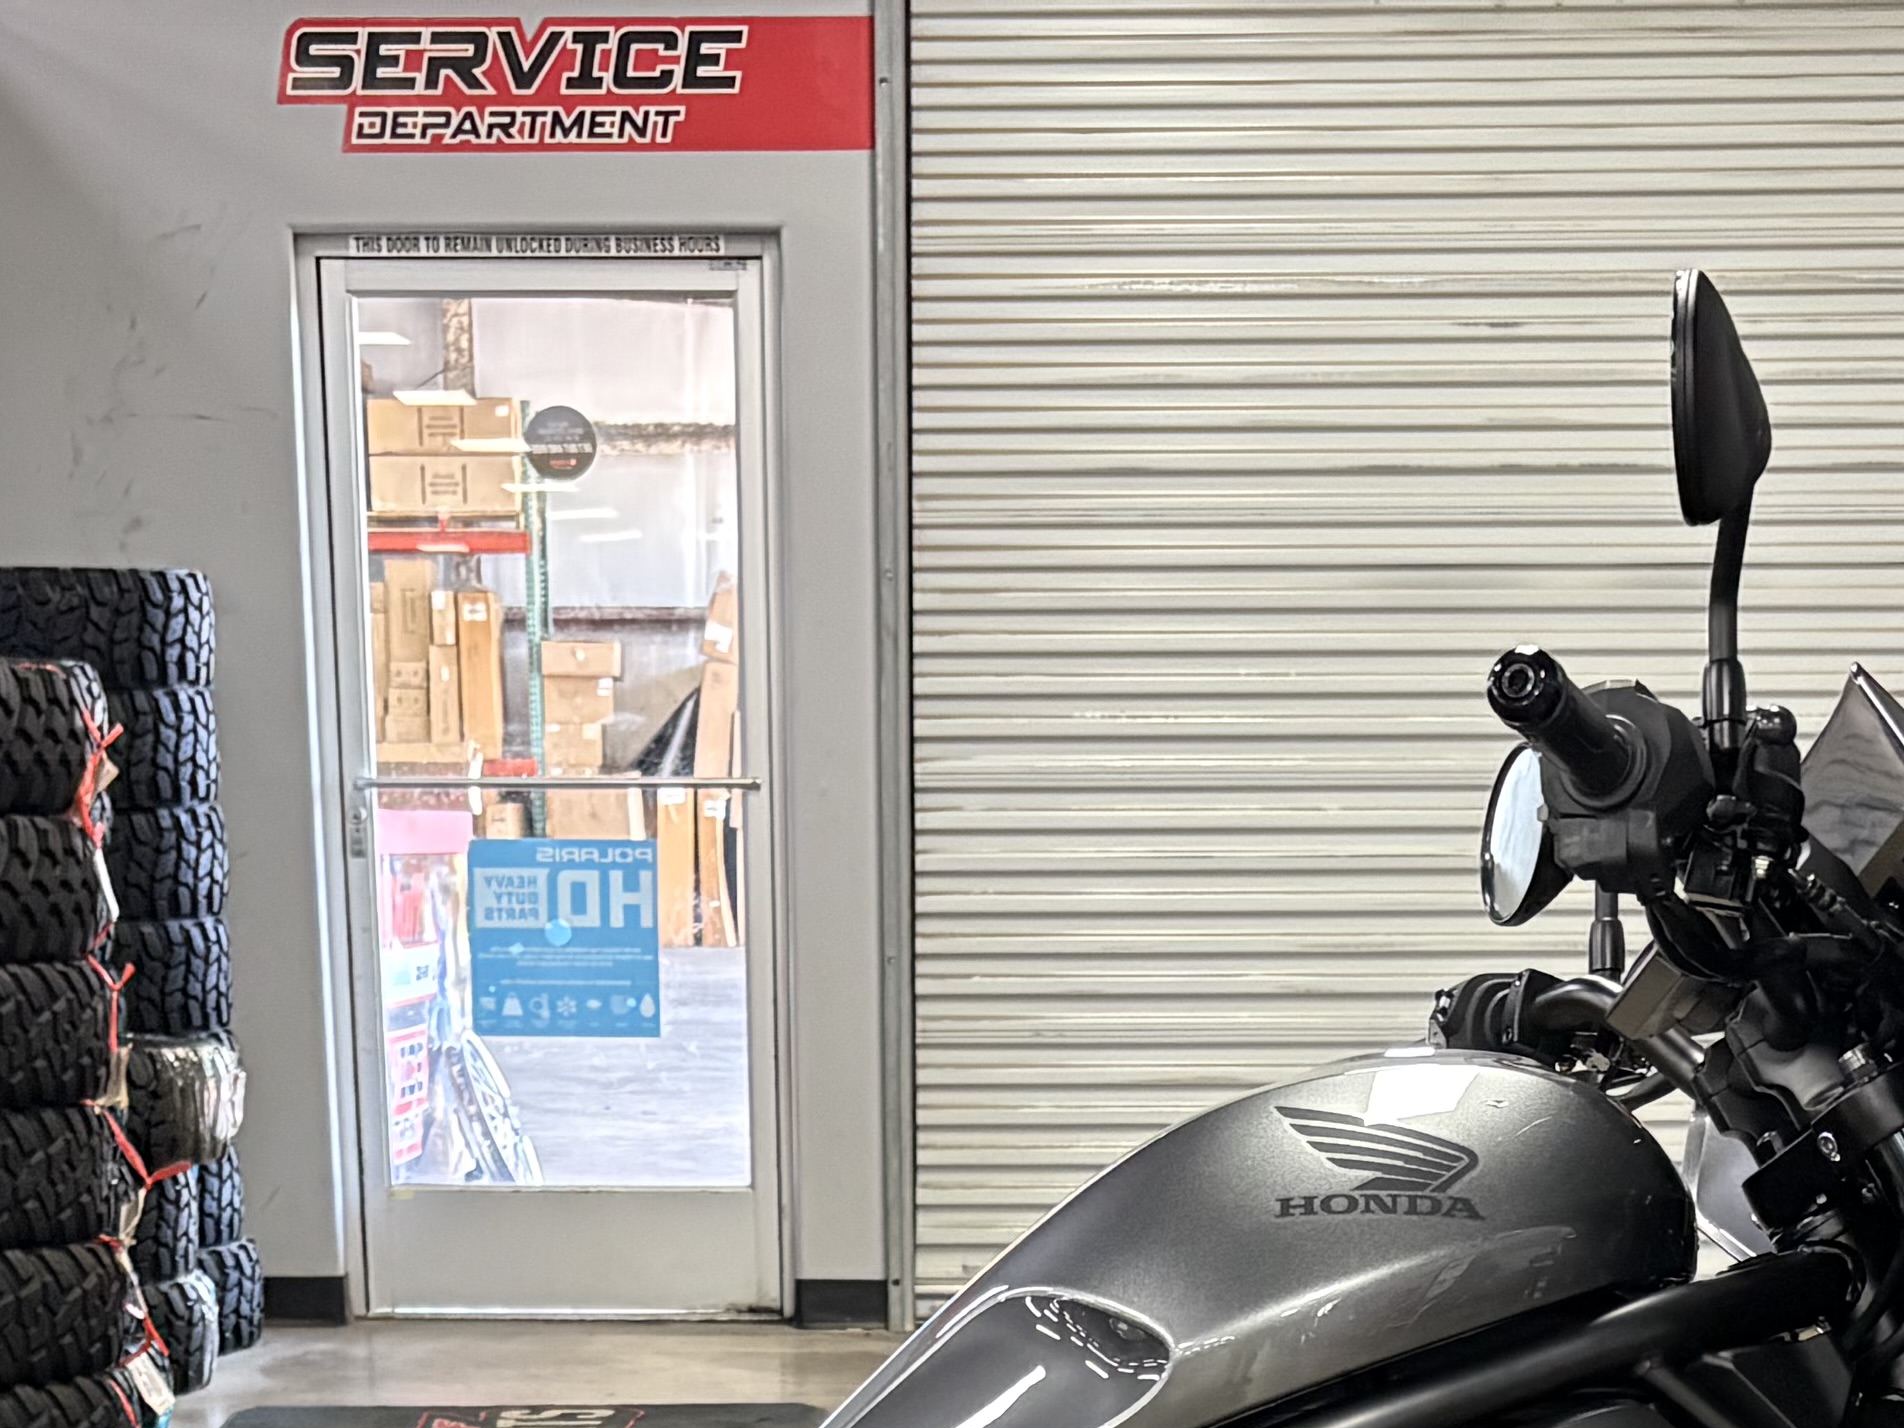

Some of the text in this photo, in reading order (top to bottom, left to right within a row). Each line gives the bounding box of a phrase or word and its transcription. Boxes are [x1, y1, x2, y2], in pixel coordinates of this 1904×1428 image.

[287, 26, 748, 95] SERVICE
[351, 106, 686, 144] DEPARTMENT
[355, 235, 721, 254] THIS DOOR TO REMAIN UNLOCKED DURING BUSINESS HOURS
[1274, 1193, 1486, 1221] HONDA
